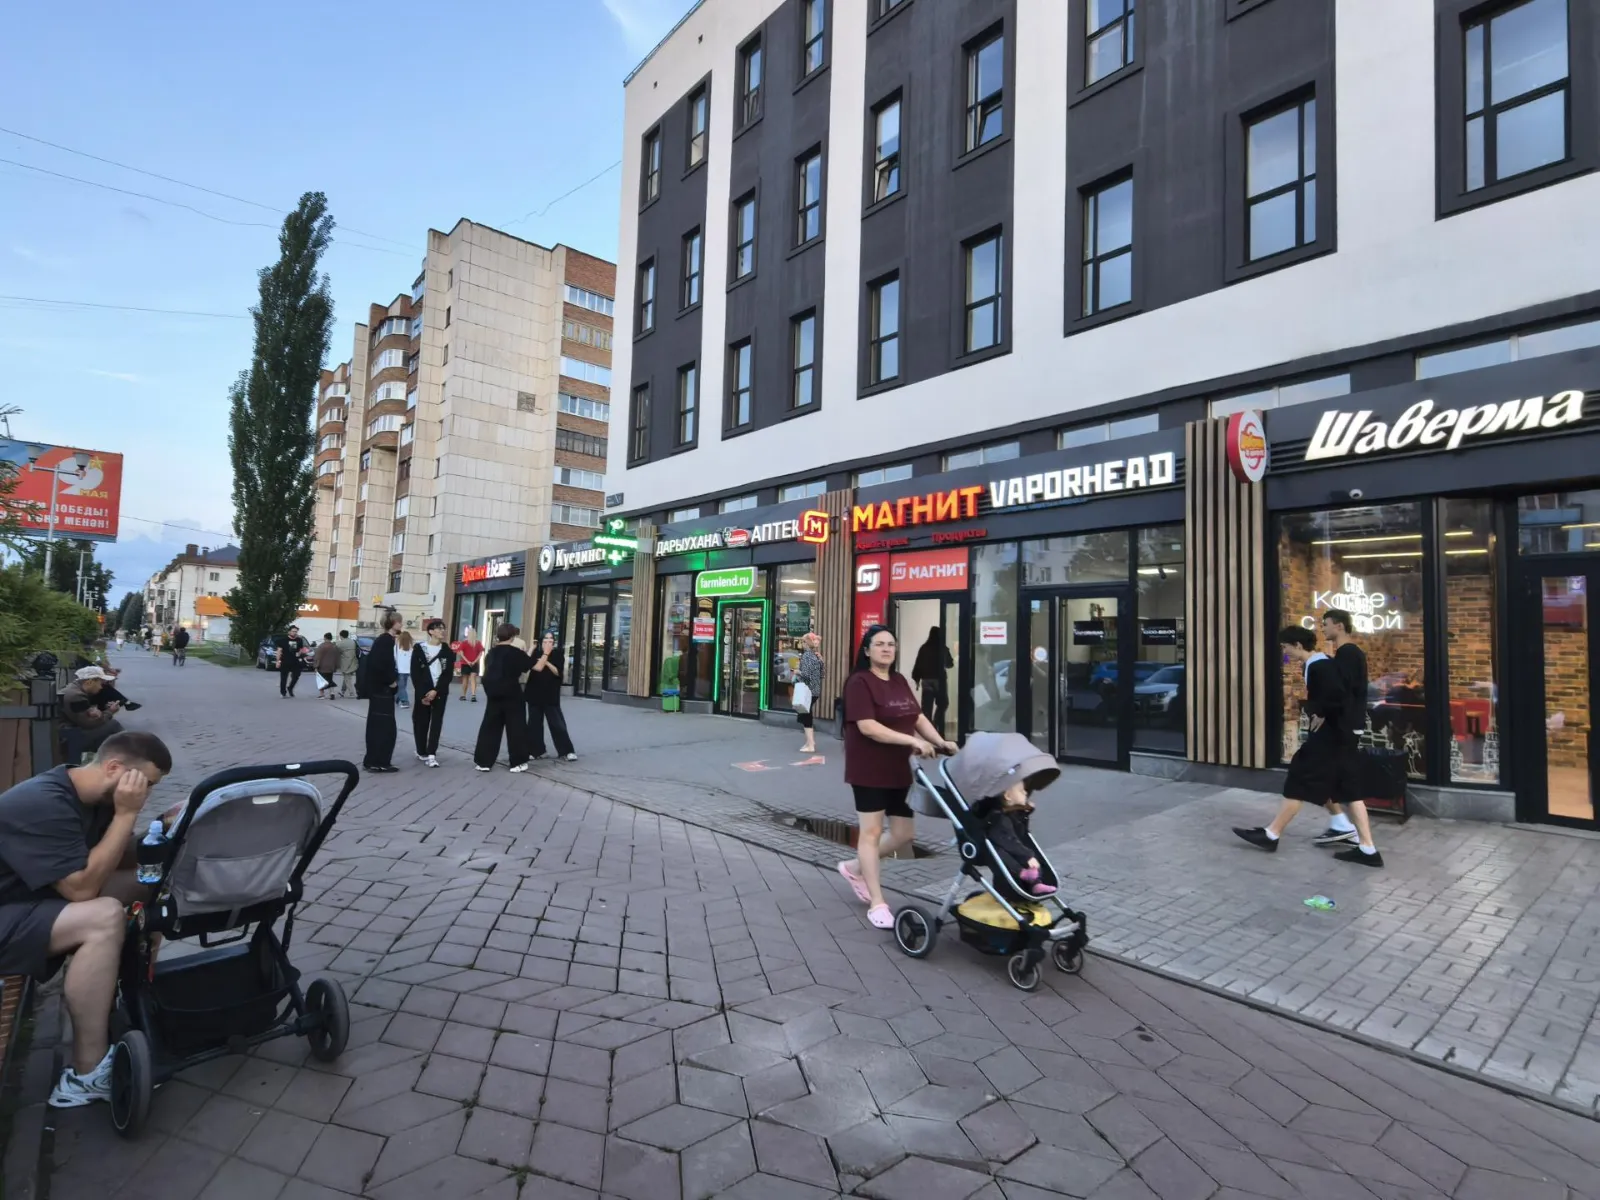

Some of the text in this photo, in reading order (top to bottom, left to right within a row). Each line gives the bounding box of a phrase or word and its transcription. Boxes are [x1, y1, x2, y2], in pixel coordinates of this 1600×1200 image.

[1304, 390, 1585, 461] Шаверма
[80, 489, 108, 499] МАЯ
[989, 451, 1176, 508] VAPORHEAD
[852, 485, 985, 532] МАГНИТ
[655, 533, 721, 557] ДАРЫУХАНА
[751, 519, 804, 543] АПТЕК
[701, 574, 749, 589] farmlend.ru
[909, 562, 967, 579] МАГНИТ
